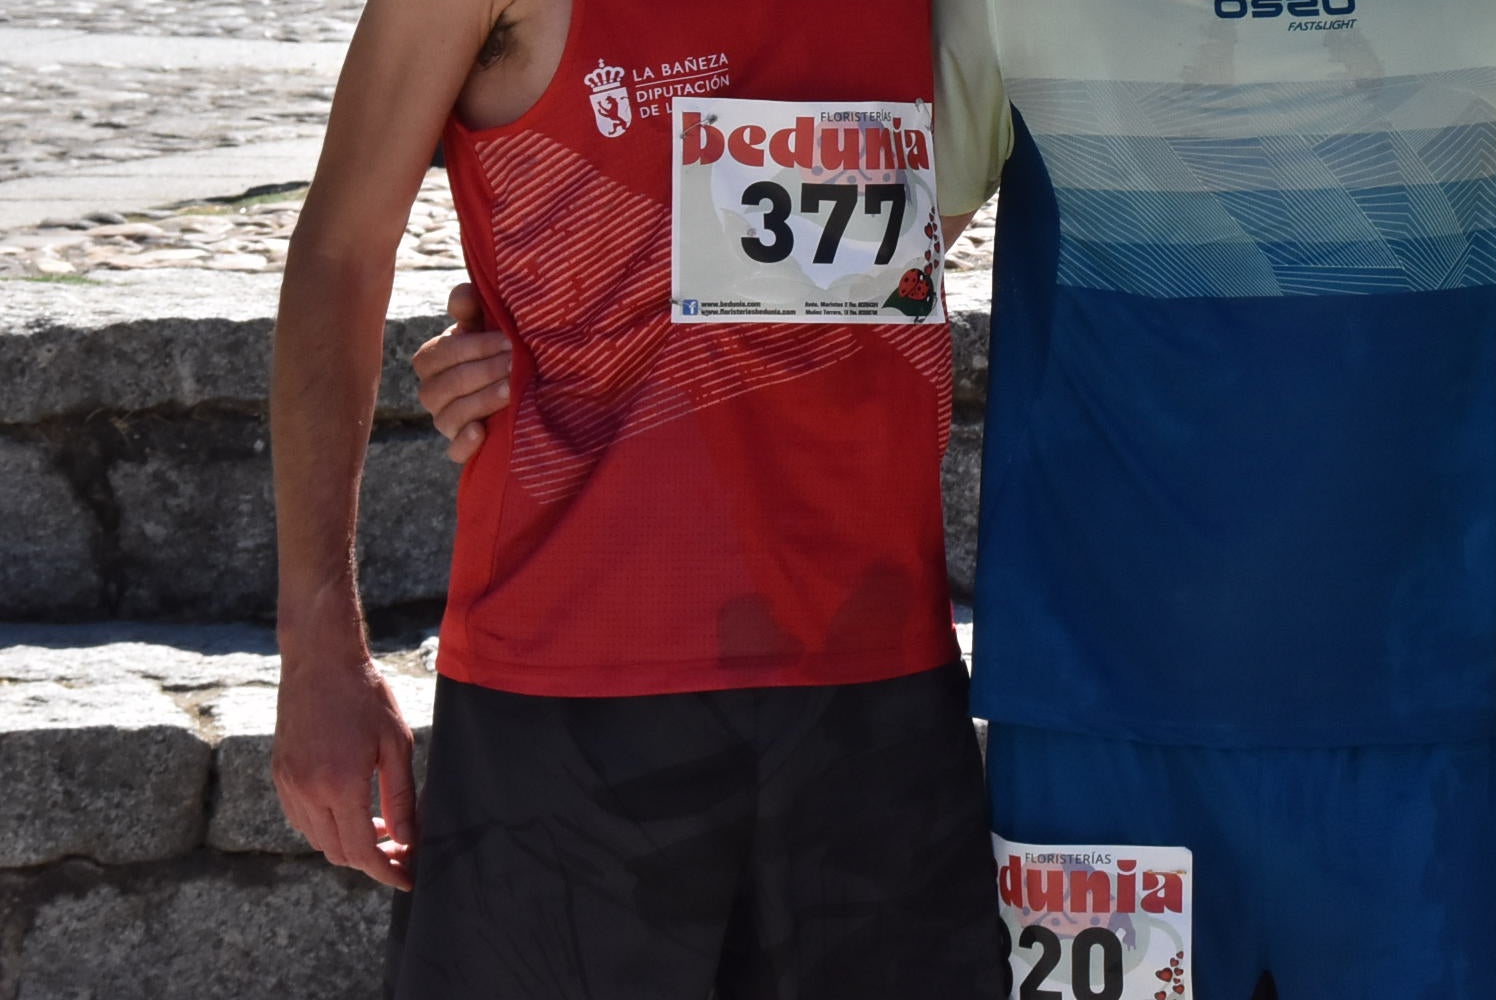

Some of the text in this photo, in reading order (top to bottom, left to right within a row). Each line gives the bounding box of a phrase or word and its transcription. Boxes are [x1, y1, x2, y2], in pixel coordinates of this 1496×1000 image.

[1287, 18, 1357, 31] FAST&LIGHT
[632, 52, 729, 82] LA BAÑEZA
[635, 74, 730, 103] DIPUTACIÓN
[639, 104, 661, 119] DE
[820, 109, 892, 122] FLORISTERÍAS
[682, 111, 930, 170] bedunia
[740, 180, 907, 266] 377
[1025, 851, 1112, 866] FLORISTERÍAS
[1000, 854, 1183, 914] dunia
